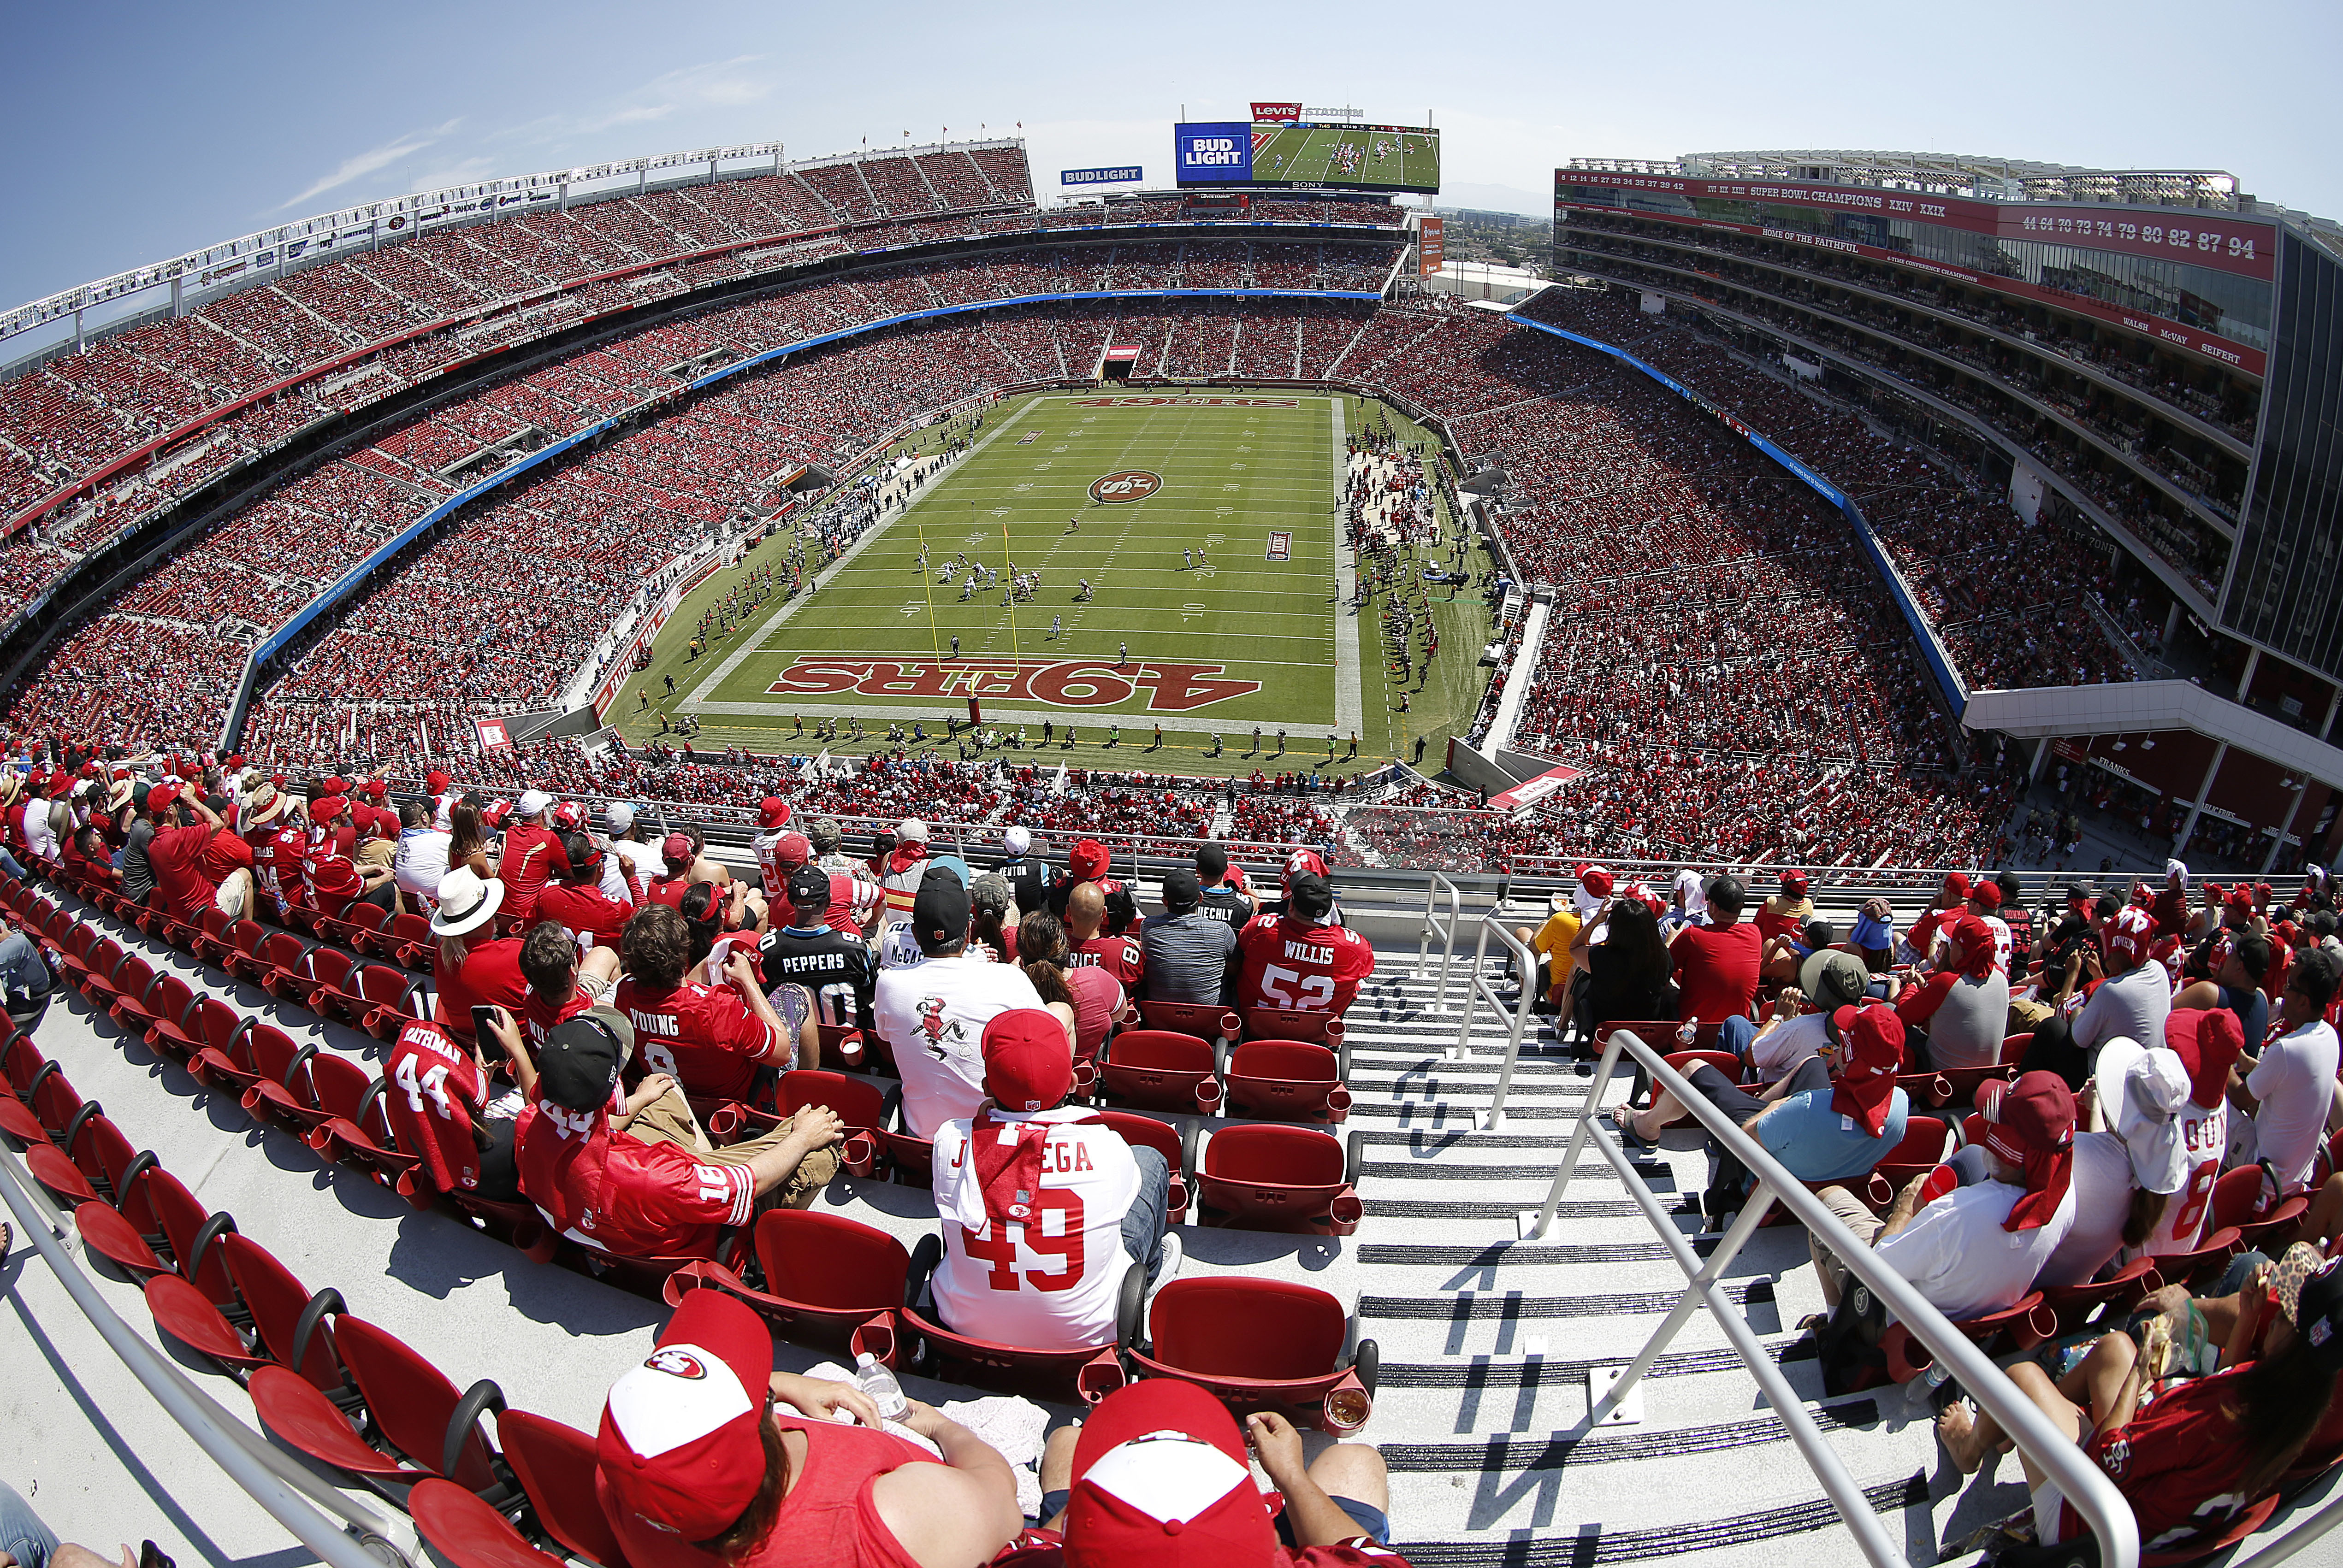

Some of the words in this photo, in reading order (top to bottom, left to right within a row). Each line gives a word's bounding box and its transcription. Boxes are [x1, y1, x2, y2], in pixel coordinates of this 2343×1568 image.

[1307, 107, 1363, 118] STADIUM
[1193, 139, 1233, 152] BUD
[1186, 151, 1241, 165] LIGHT
[506, 195, 521, 203] pepsi
[1751, 186, 1779, 198] SUPER
[1781, 189, 1809, 201] BOWL
[1811, 191, 1882, 208] CHAMPIONS
[1889, 199, 1913, 212] XXIV
[1919, 203, 1946, 217] XXIX
[420, 212, 442, 221] BROCADE
[455, 203, 476, 214] YAHOO!
[343, 230, 367, 238] UNITED
[1763, 229, 1783, 239] HOME
[1785, 231, 1795, 240] OF
[1796, 233, 1812, 244] THE
[1815, 236, 1858, 253] FAITHFUL
[2023, 216, 2036, 230] 44
[2039, 218, 2053, 231] 64
[2058, 218, 2071, 233] 70
[2096, 221, 2112, 237] 74
[2118, 223, 2136, 240] 79
[2142, 225, 2162, 243] 80
[2168, 229, 2191, 248] 82
[2197, 232, 2221, 252] 87
[2228, 236, 2254, 259] 94
[289, 245, 304, 256] SAP
[320, 239, 332, 249] nrg
[215, 267, 231, 279] Dignity
[231, 263, 246, 274] Health
[258, 257, 273, 267] LIGHT
[1887, 256, 1905, 265] 6-TIME
[1905, 260, 1940, 273] CONFERENCE
[1941, 269, 1977, 283] CHAMPIONS
[455, 310, 480, 322] 5-TIME
[481, 303, 503, 314] SUPER
[505, 297, 524, 307] BOWL
[525, 285, 563, 300] CHAMPIONS
[633, 298, 652, 308] WELCOME
[674, 289, 691, 297] STADIUM
[2123, 317, 2149, 332] WALSH
[509, 336, 535, 349] WELCOME
[543, 326, 559, 337] LEVI'S
[562, 319, 584, 330] STADIUM
[2160, 329, 2188, 345] McVAY
[2201, 343, 2241, 365] SEIFERT
[349, 395, 381, 413] WELCOME
[393, 382, 413, 395] LEVI'S
[417, 368, 444, 384] STADIUM
[951, 400, 979, 415] FAITHFUL
[1067, 397, 1300, 409] 49ERS
[471, 485, 484, 496] routes
[484, 480, 492, 490] lead
[497, 466, 520, 481] touchdowns
[1794, 465, 1804, 477] routes
[1814, 478, 1834, 499] touchdowns
[92, 542, 113, 560] UNITED
[324, 591, 337, 605] routes
[336, 584, 345, 594] lead
[349, 563, 372, 585] touchdowns
[259, 646, 273, 658] UNITED
[610, 644, 641, 696] FAITHFUL
[640, 620, 657, 648] THEN
[763, 655, 1263, 712] 49ERS
[2099, 757, 2130, 776] FRANKS
[2219, 808, 2236, 819] FRIES
[2285, 831, 2301, 845] DOGS
[254, 845, 274, 858] THOMAS
[999, 866, 1027, 877] NEWTON
[1197, 908, 1233, 921] UECHLY
[2004, 910, 2028, 920] BOWMAN
[1070, 953, 1101, 968] RICE
[1284, 940, 1335, 965] WILLIS
[782, 952, 845, 974] PEPPERS
[1257, 963, 1336, 1012] 52
[630, 1008, 680, 1037] YOUNG
[402, 1026, 463, 1067] RATHMAN
[395, 1052, 451, 1120] 44
[692, 1163, 730, 1205] 16
[2171, 1157, 2220, 1241] 8
[961, 1188, 1084, 1292] 49
